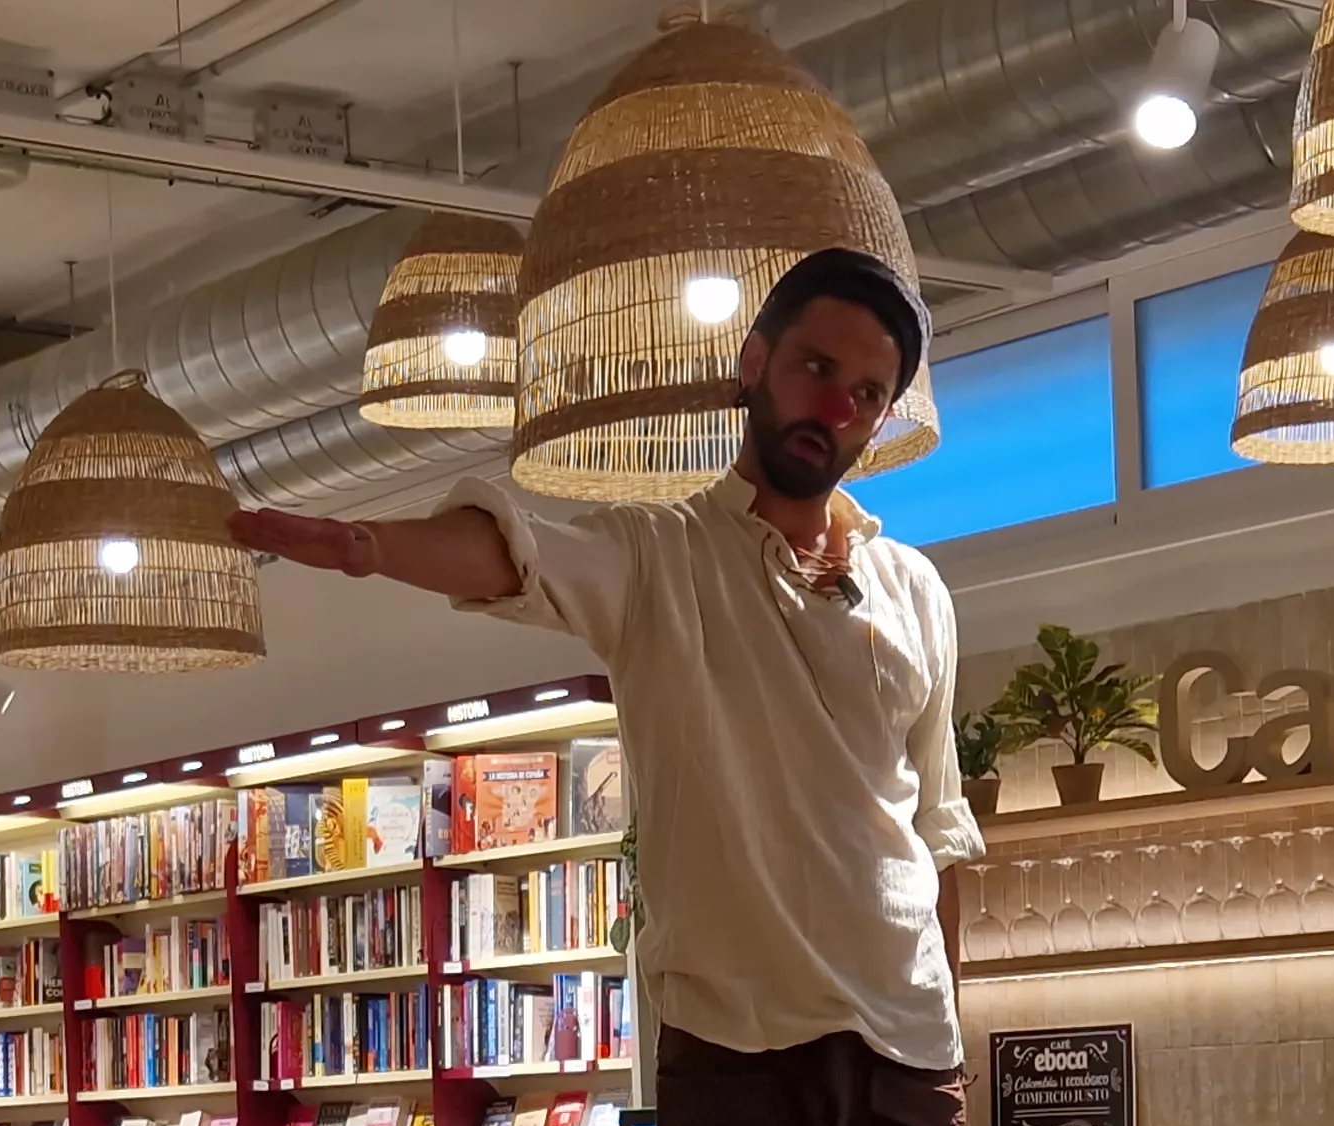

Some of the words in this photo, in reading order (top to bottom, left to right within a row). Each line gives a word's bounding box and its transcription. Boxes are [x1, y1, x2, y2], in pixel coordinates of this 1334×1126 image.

[1050, 1038, 1072, 1051] CAFÉ
[1034, 1047, 1088, 1072] eboca
[1065, 1072, 1109, 1088] ECOLÓGICO
[1014, 1090, 1073, 1106] COMERCIO
[1073, 1088, 1110, 1103] JUSTO
